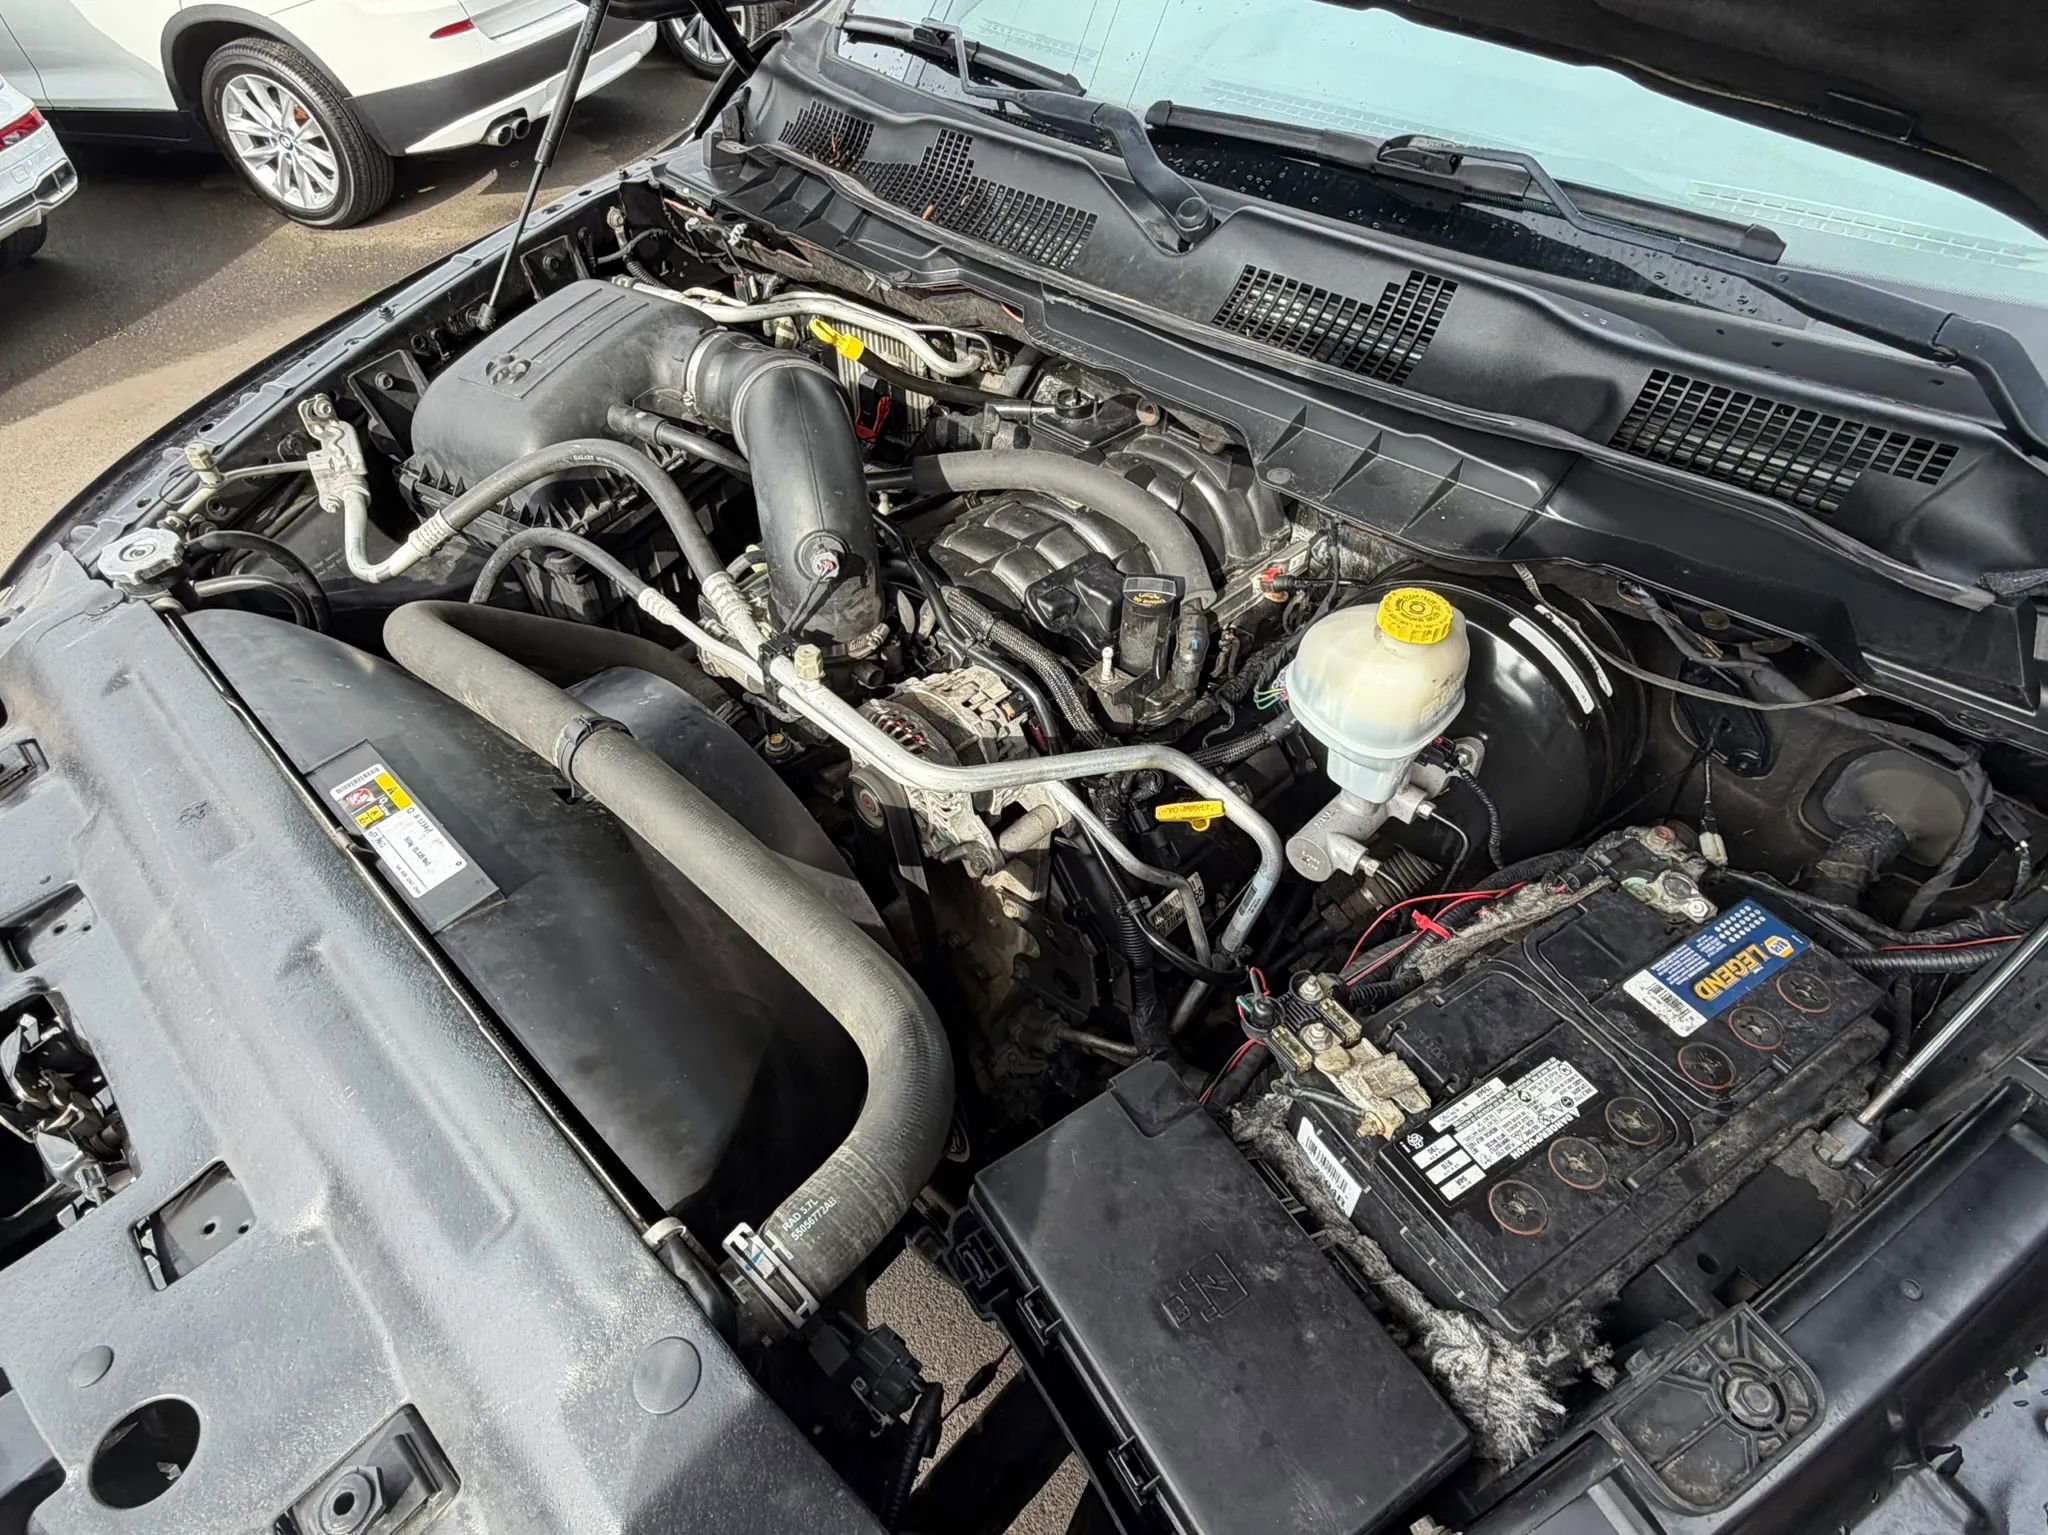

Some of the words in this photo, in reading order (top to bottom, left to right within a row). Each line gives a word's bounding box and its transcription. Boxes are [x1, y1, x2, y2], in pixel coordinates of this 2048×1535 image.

[1693, 943, 1771, 1002] LEGEND
[1508, 1112, 1574, 1160] DANGER/POISON
[782, 1212, 801, 1231] RAD
[800, 1199, 819, 1214] 5.7L
